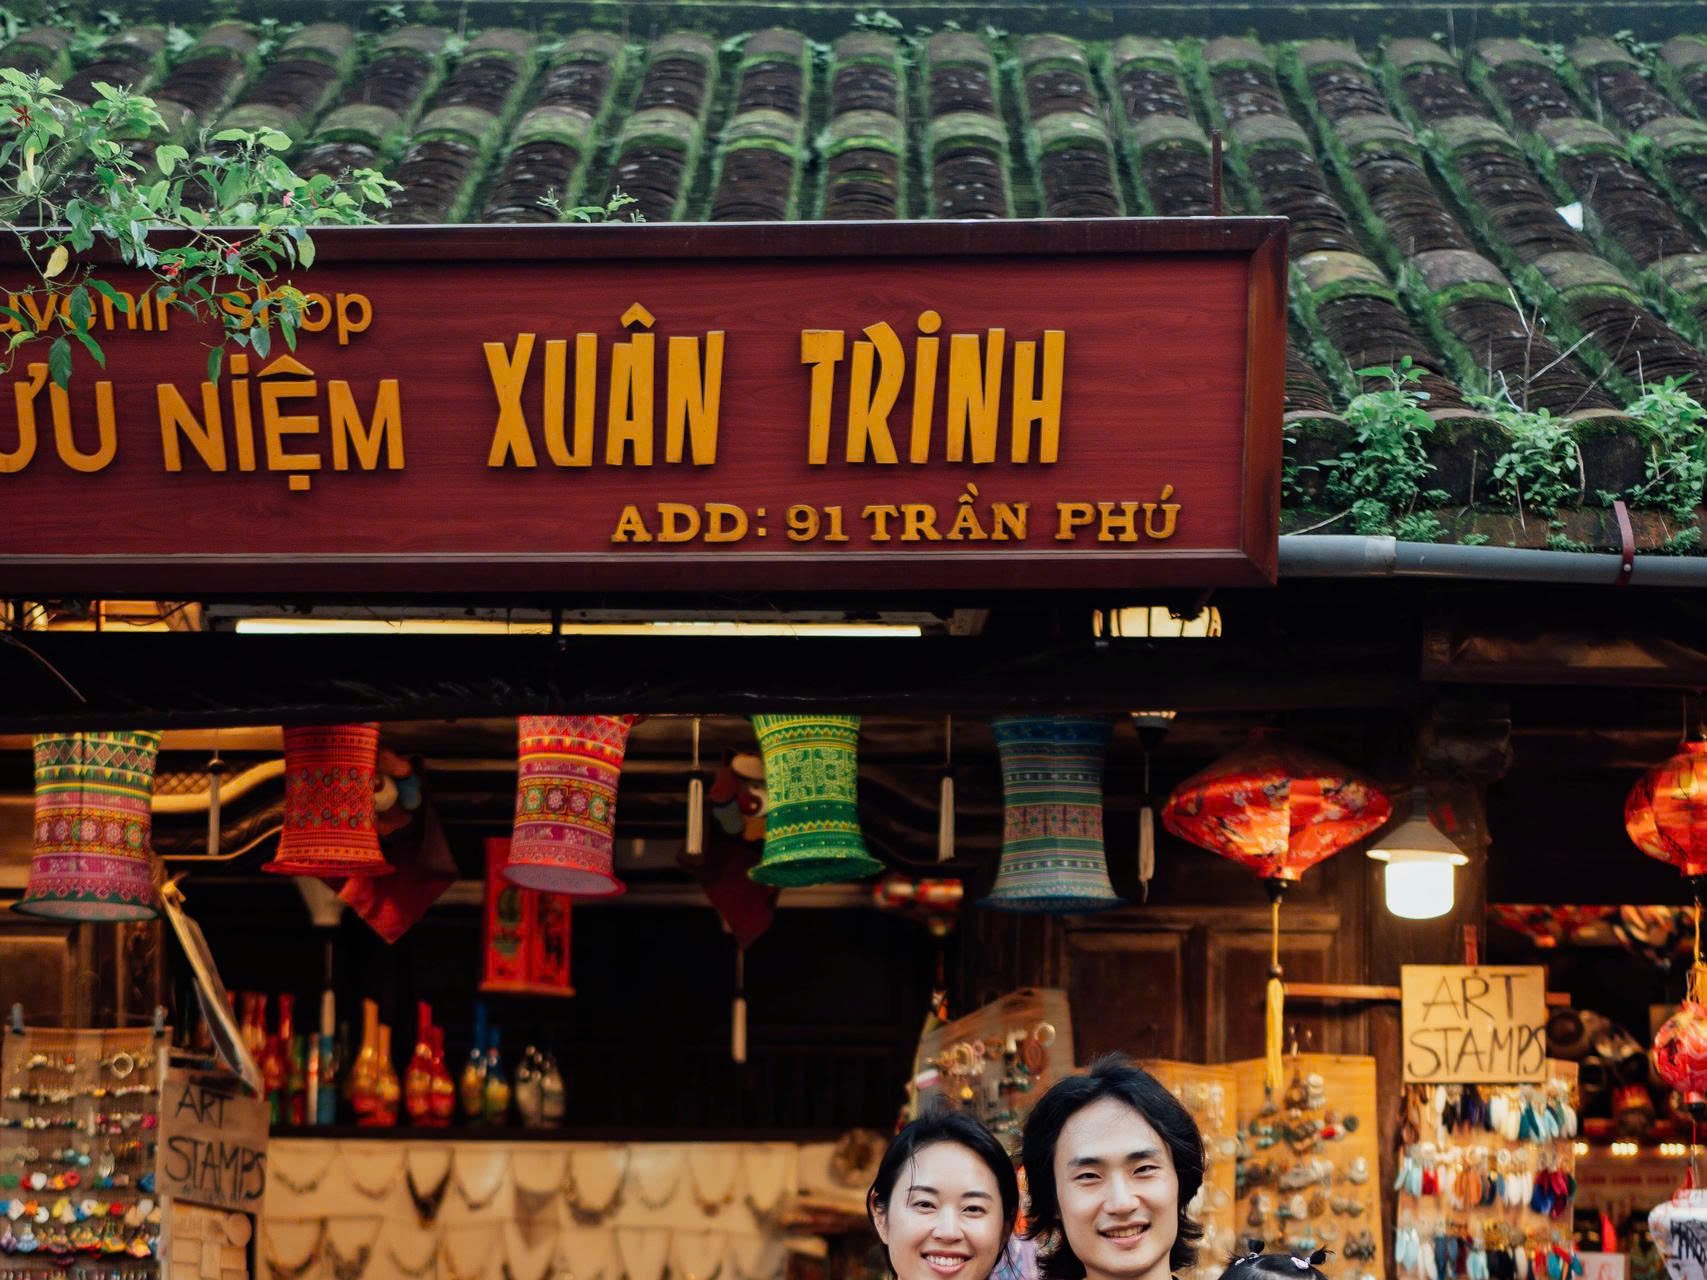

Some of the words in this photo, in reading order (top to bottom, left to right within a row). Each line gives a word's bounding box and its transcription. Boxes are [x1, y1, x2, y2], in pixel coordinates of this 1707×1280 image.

[483, 302, 725, 467] XUÂN
[611, 502, 767, 542] ADD:
[786, 504, 849, 541] 91
[861, 482, 1031, 541] TRẦN
[1054, 484, 1182, 541] PHÚ
[1422, 973, 1527, 1022] ART
[1407, 1025, 1547, 1078] STAMPS
[175, 1084, 234, 1130] ART
[165, 1135, 268, 1200] STAMPS
